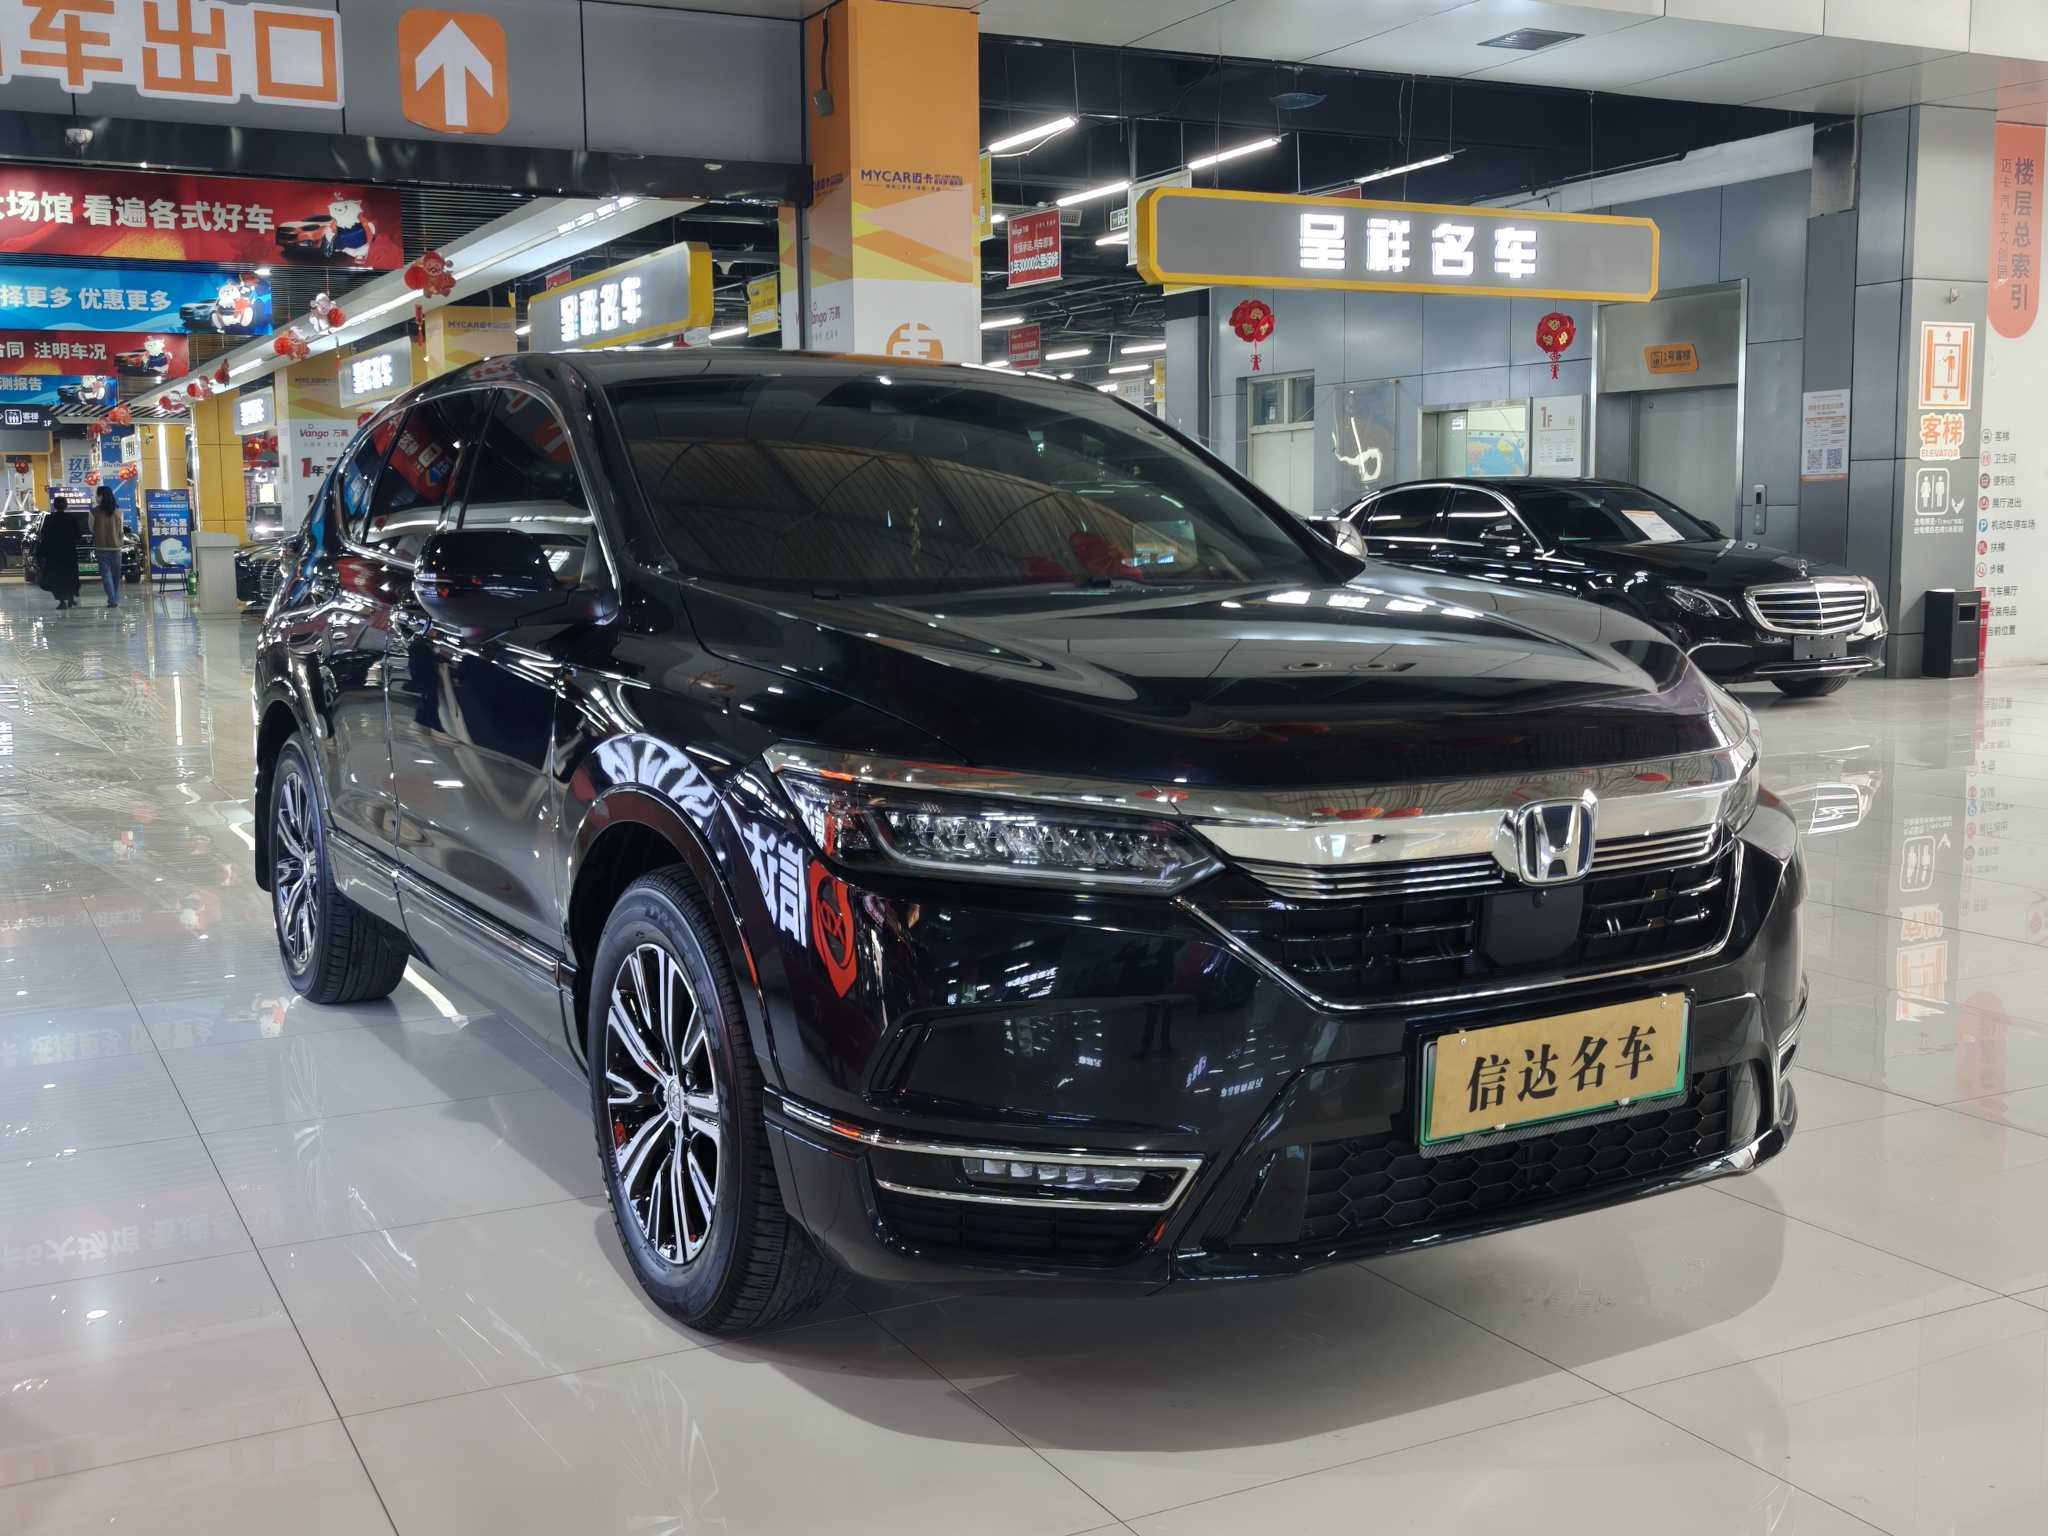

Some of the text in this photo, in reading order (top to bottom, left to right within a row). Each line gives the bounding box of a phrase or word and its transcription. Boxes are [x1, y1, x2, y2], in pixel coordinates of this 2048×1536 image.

[0, 0, 338, 102] 车出口
[0, 190, 275, 234] 场馆 看遍各式好车
[1300, 213, 1539, 279] 呈祥名车
[2011, 157, 2034, 311] 楼层总索引
[79, 287, 172, 312] 优惠更多
[33, 342, 107, 361] 注明车况
[1921, 415, 1964, 446] 客梯
[1921, 449, 1959, 458] ELEVATOR
[1991, 519, 2036, 531] 机动车停车场
[1466, 1025, 1657, 1113] 信达名车
